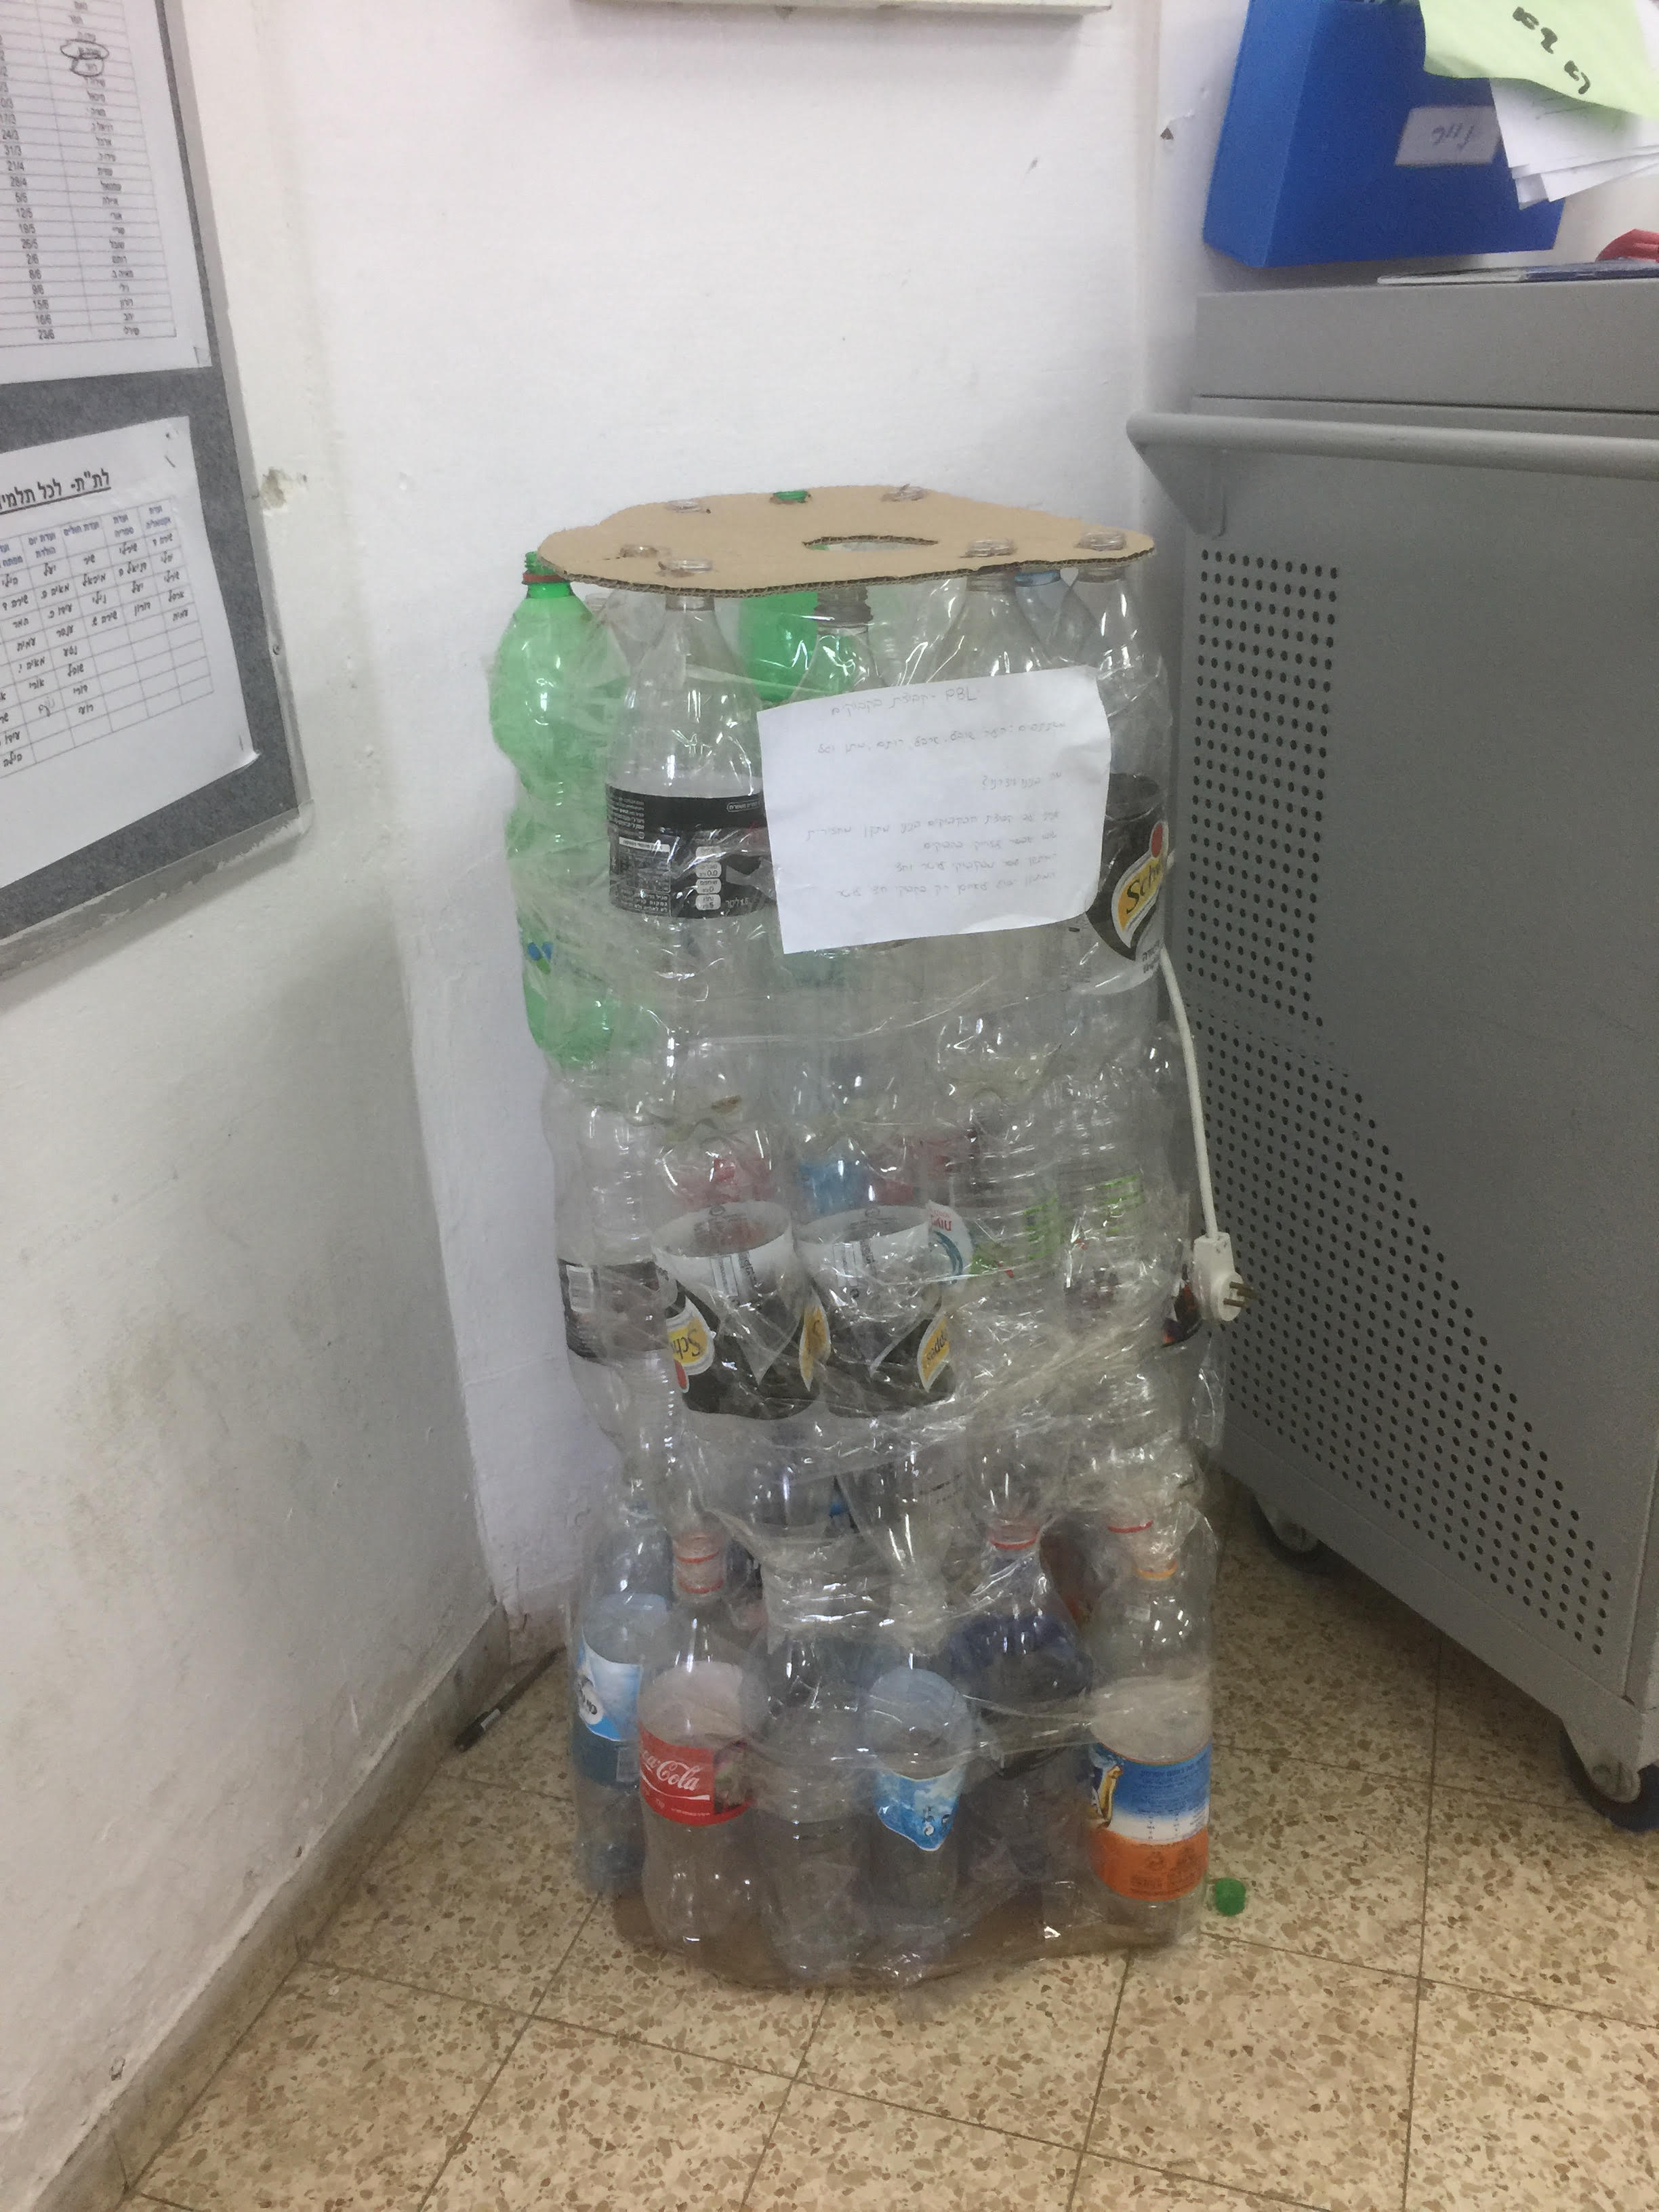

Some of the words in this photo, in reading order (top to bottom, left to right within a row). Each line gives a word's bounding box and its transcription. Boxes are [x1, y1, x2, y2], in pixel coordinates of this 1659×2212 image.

[5, 144, 22, 155] 31/3
[7, 160, 24, 171] 21/4
[38, 478, 62, 499] לכל
[0, 487, 35, 510] תלמי
[945, 687, 978, 701] PBL
